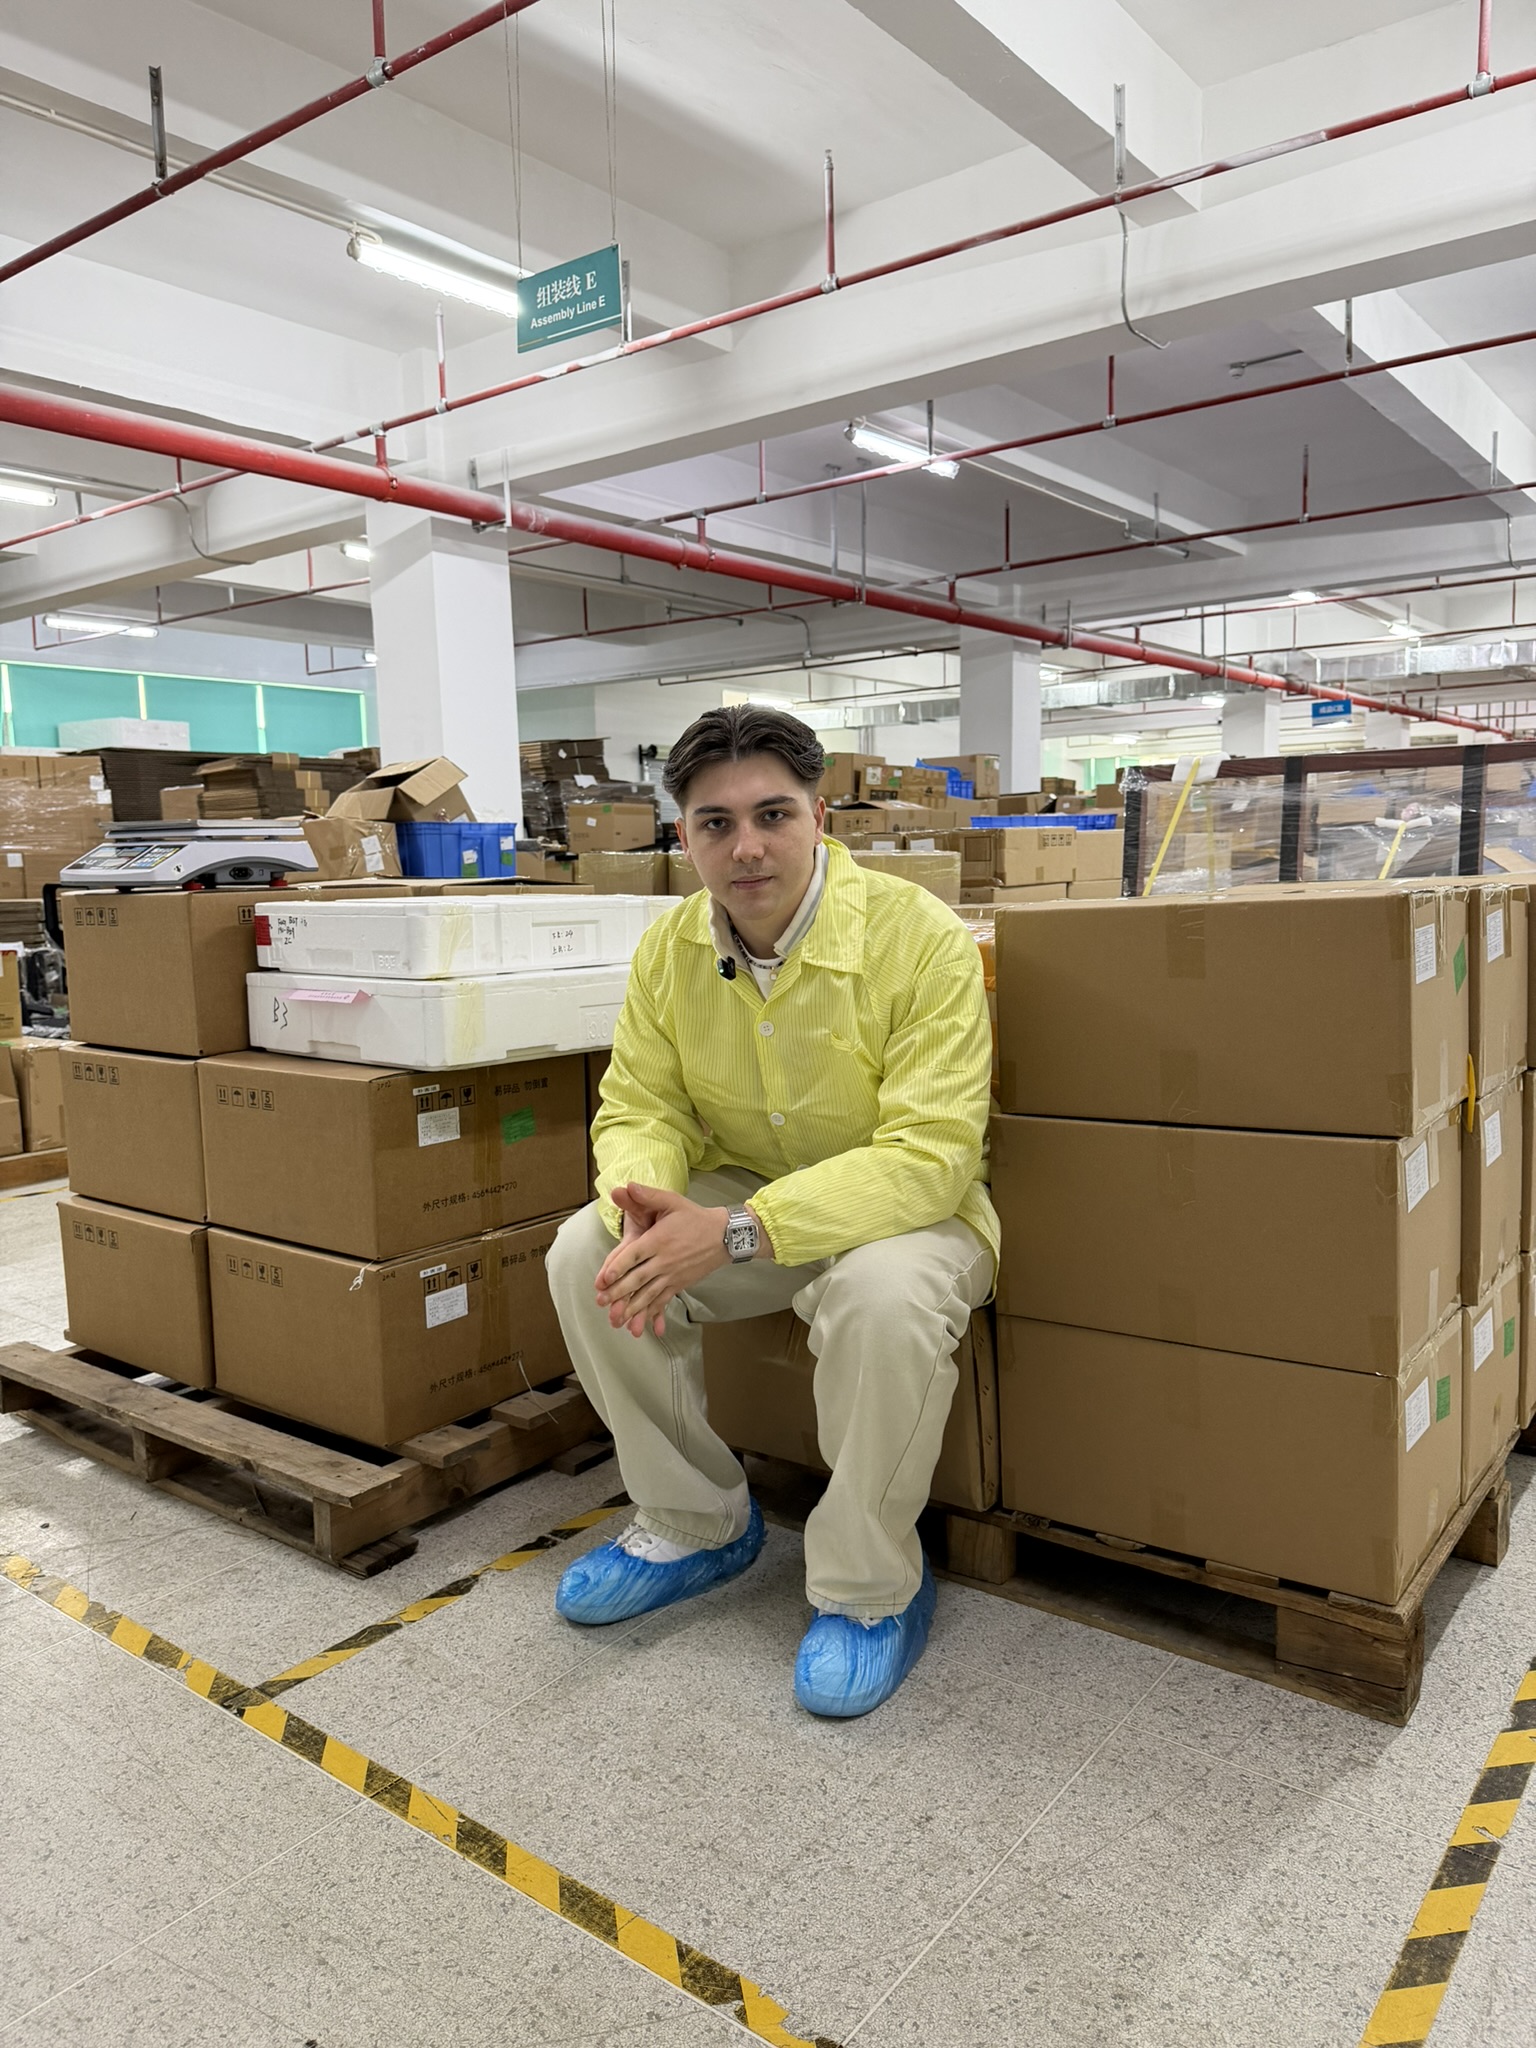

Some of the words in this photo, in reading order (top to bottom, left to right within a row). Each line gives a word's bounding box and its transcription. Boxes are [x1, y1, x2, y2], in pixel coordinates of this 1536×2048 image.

[536, 274, 582, 309] 组装线
[585, 270, 598, 291] E
[530, 306, 575, 329] Assembly
[576, 299, 597, 315] Line
[598, 294, 606, 308] E
[530, 1242, 551, 1259] 勿倒
